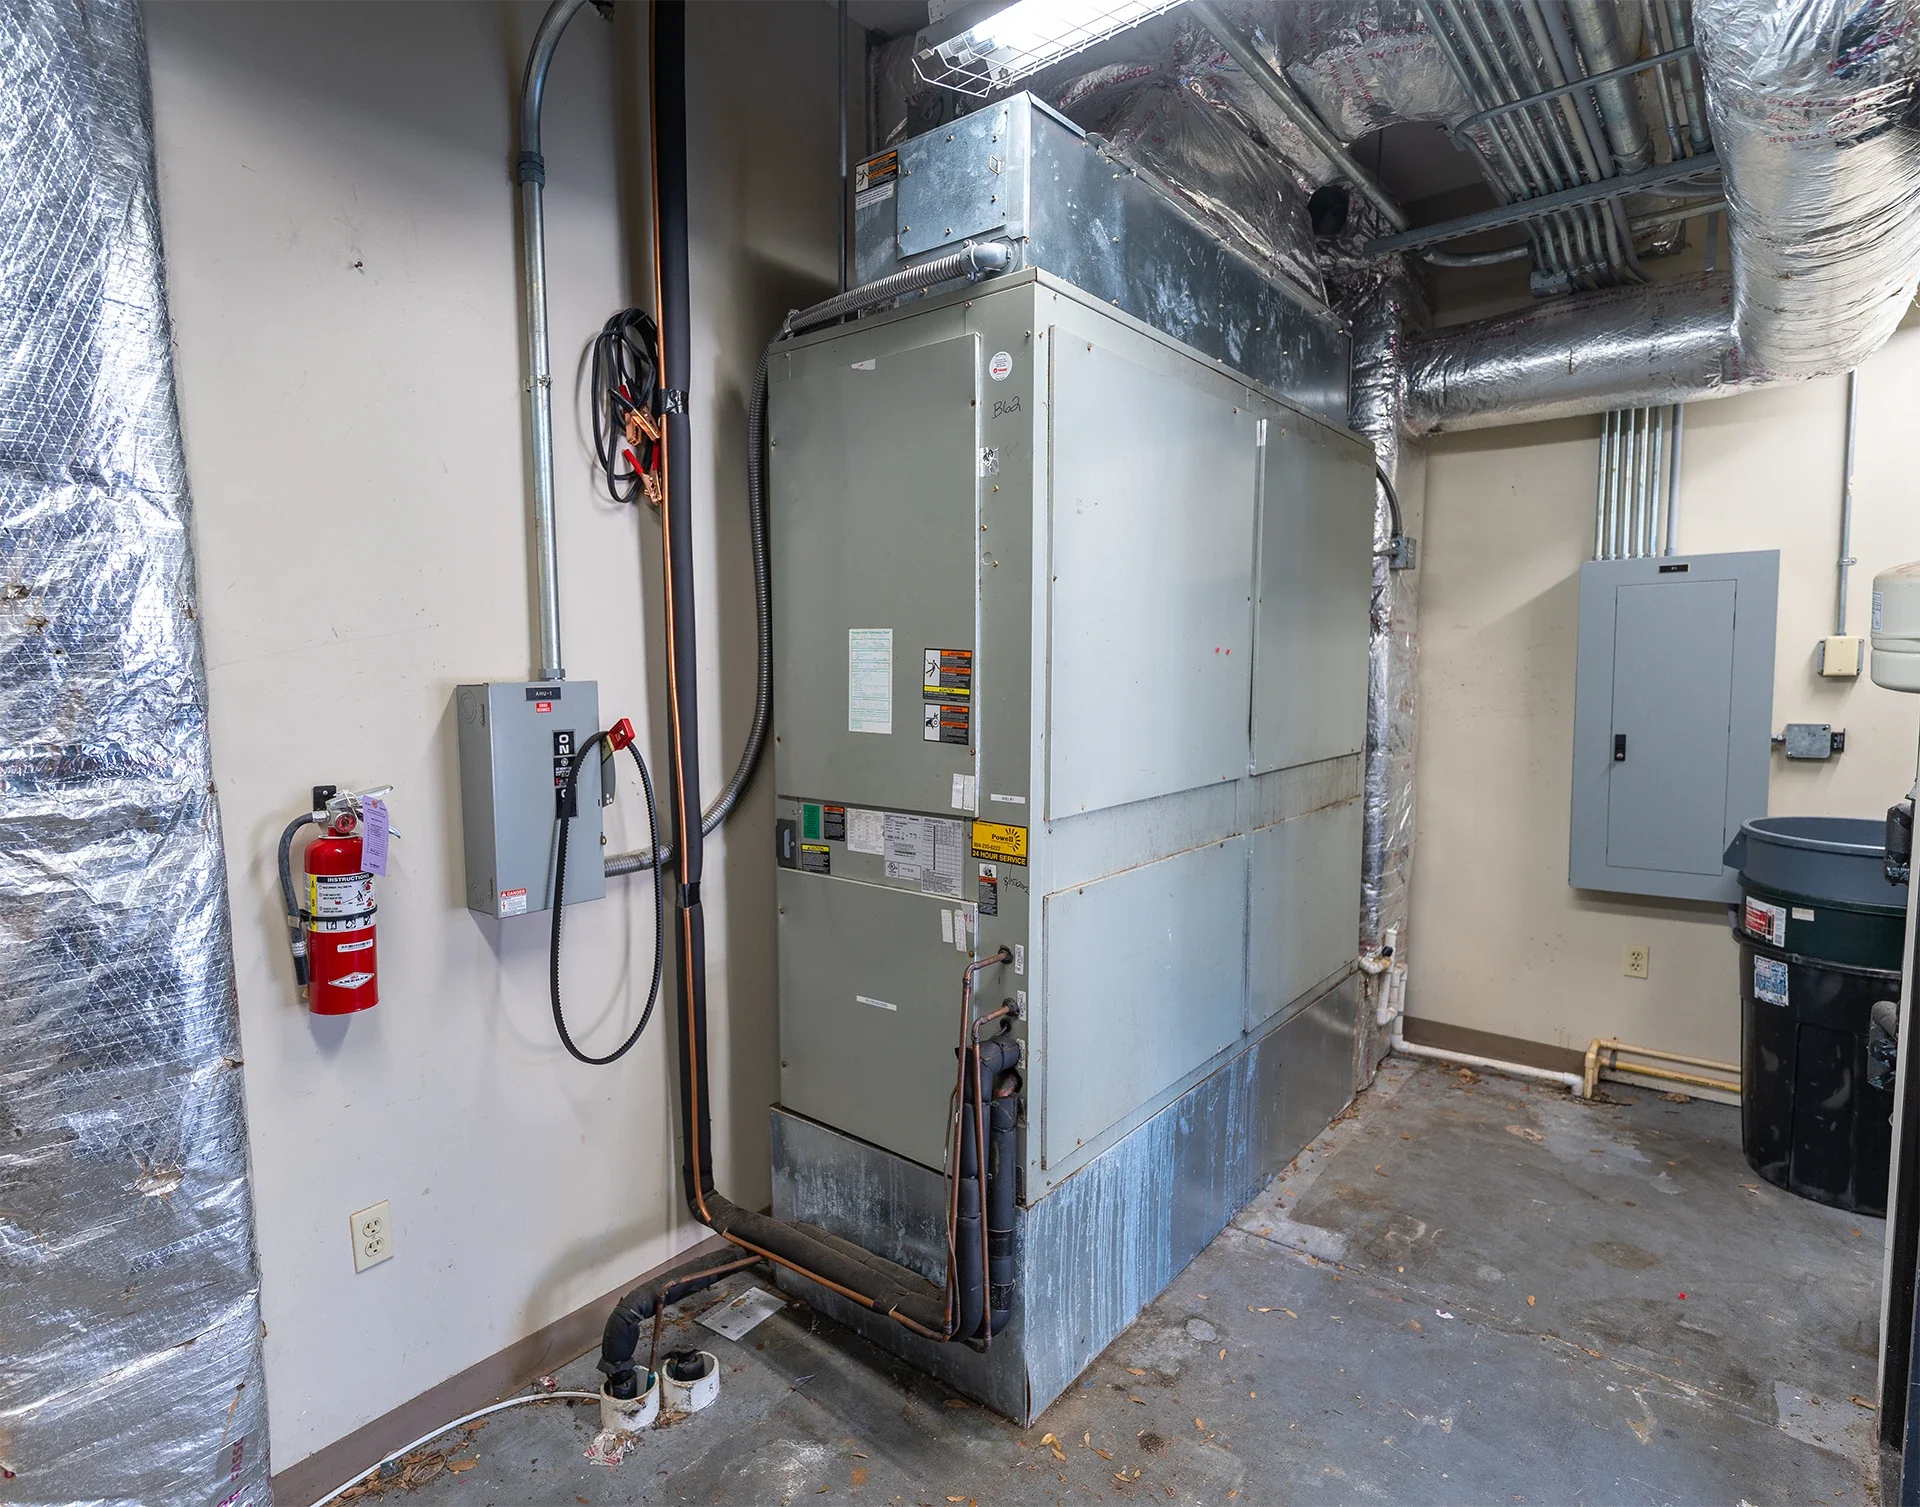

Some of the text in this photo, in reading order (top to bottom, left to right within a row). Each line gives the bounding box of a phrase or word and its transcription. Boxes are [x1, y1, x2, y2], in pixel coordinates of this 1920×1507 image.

[991, 833, 1015, 843] Powell
[972, 849, 1026, 866] 24 HOUR SERVICE
[327, 872, 370, 883] INSTRUCTIONS
